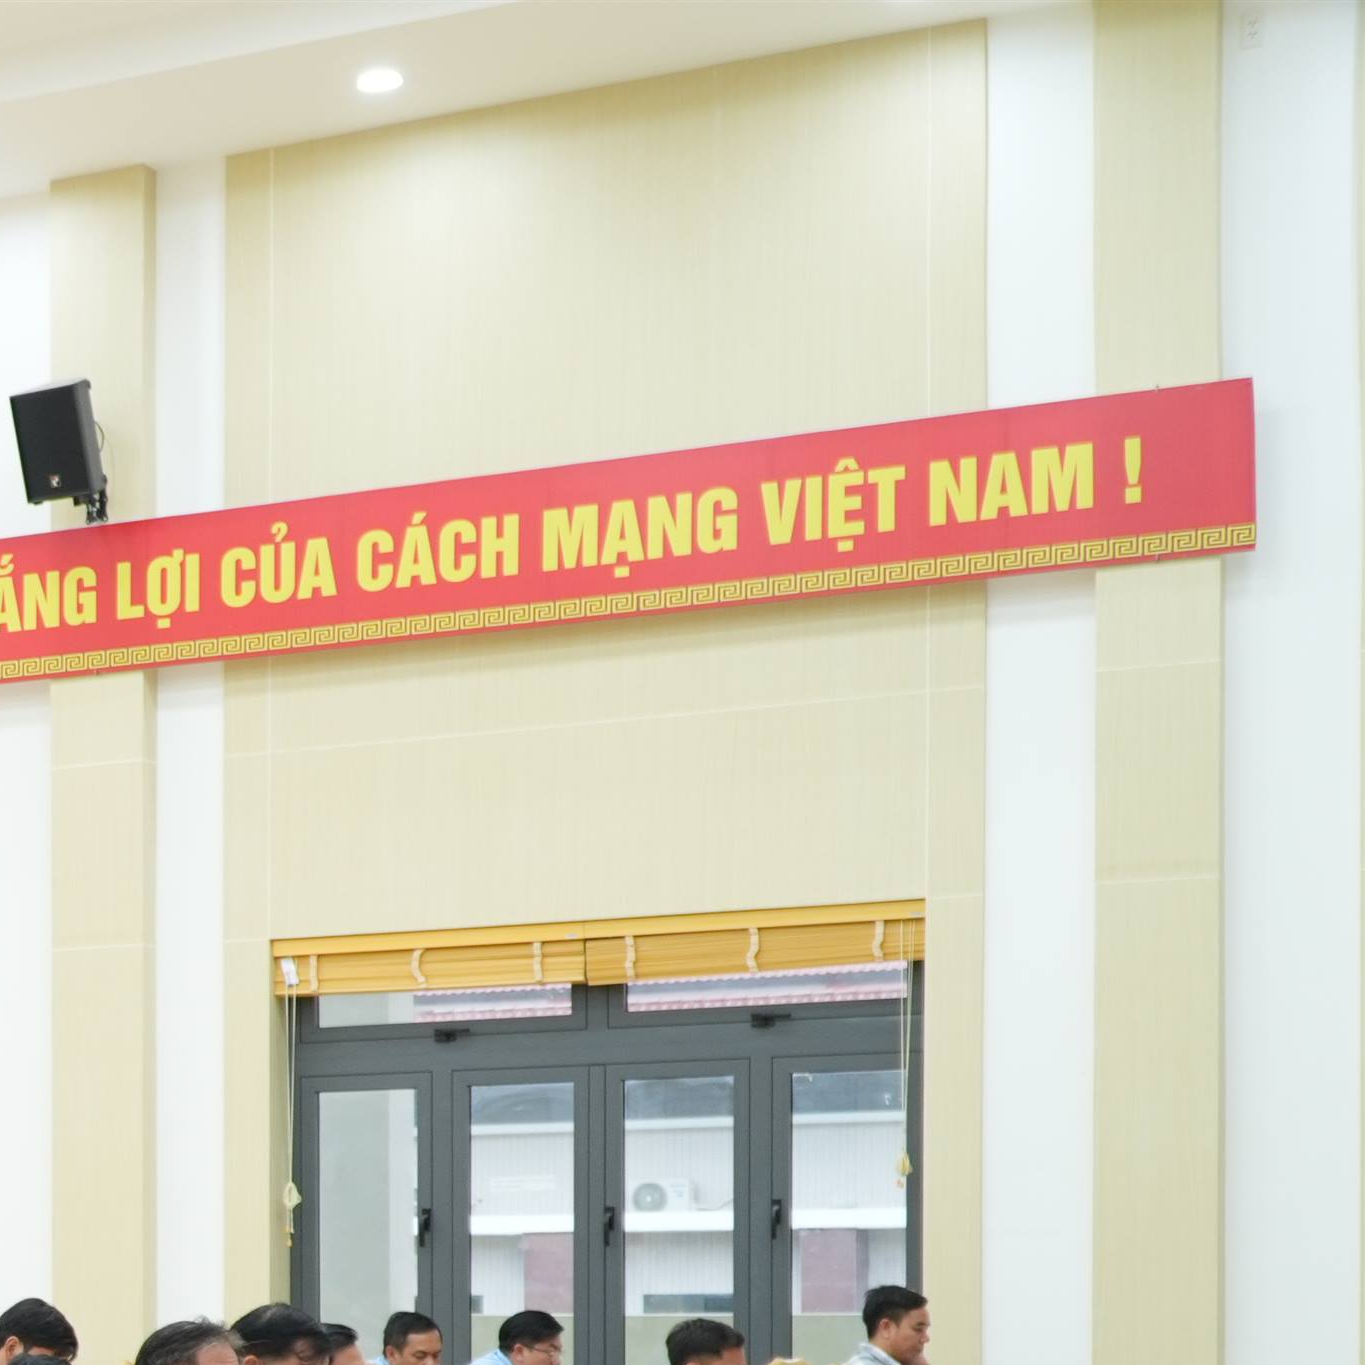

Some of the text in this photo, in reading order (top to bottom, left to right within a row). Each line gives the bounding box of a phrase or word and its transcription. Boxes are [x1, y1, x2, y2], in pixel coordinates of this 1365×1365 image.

[117, 549, 200, 629] LỢI
[221, 522, 337, 608] CỦA
[357, 511, 520, 592] CÁCH
[542, 487, 738, 578] MẠNG
[761, 458, 906, 552] VIỆT
[929, 443, 1094, 527] NAM
[1124, 437, 1142, 504] !
